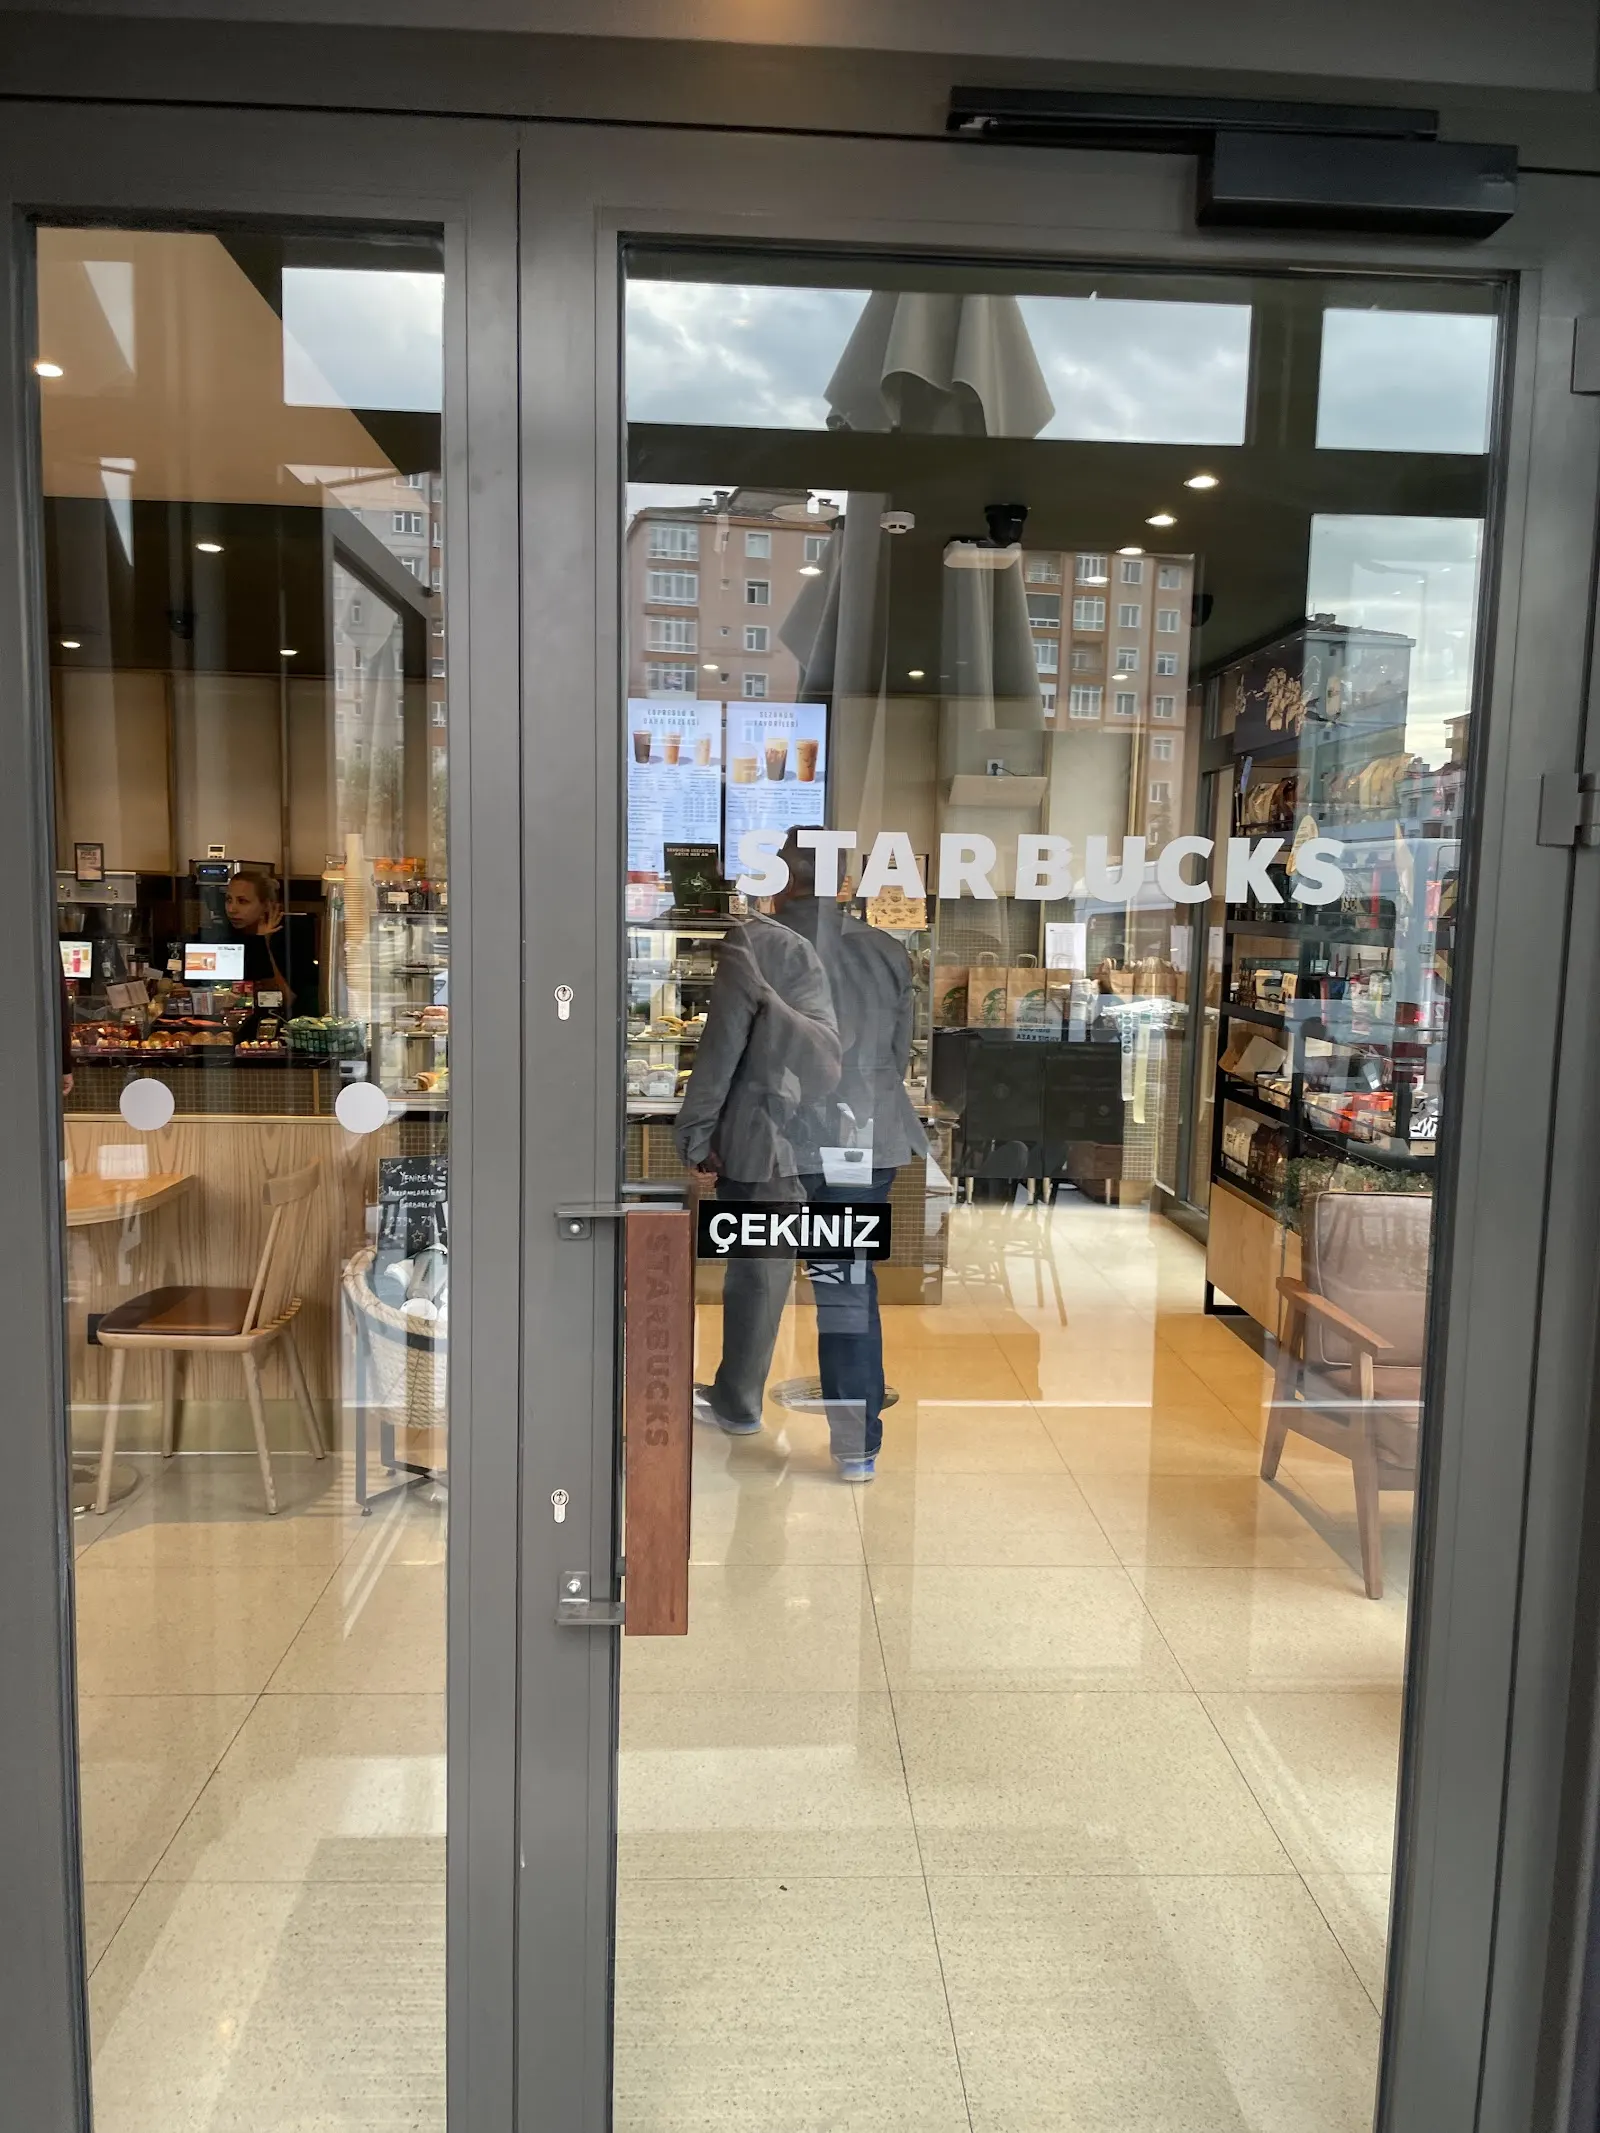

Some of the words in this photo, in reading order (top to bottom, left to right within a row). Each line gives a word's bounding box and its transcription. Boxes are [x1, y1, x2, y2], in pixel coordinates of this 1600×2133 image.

[735, 829, 1346, 906] STARBUCKS
[708, 1205, 880, 1254] ÇEKİNİZ
[644, 1232, 671, 1449] STARBUCKS
